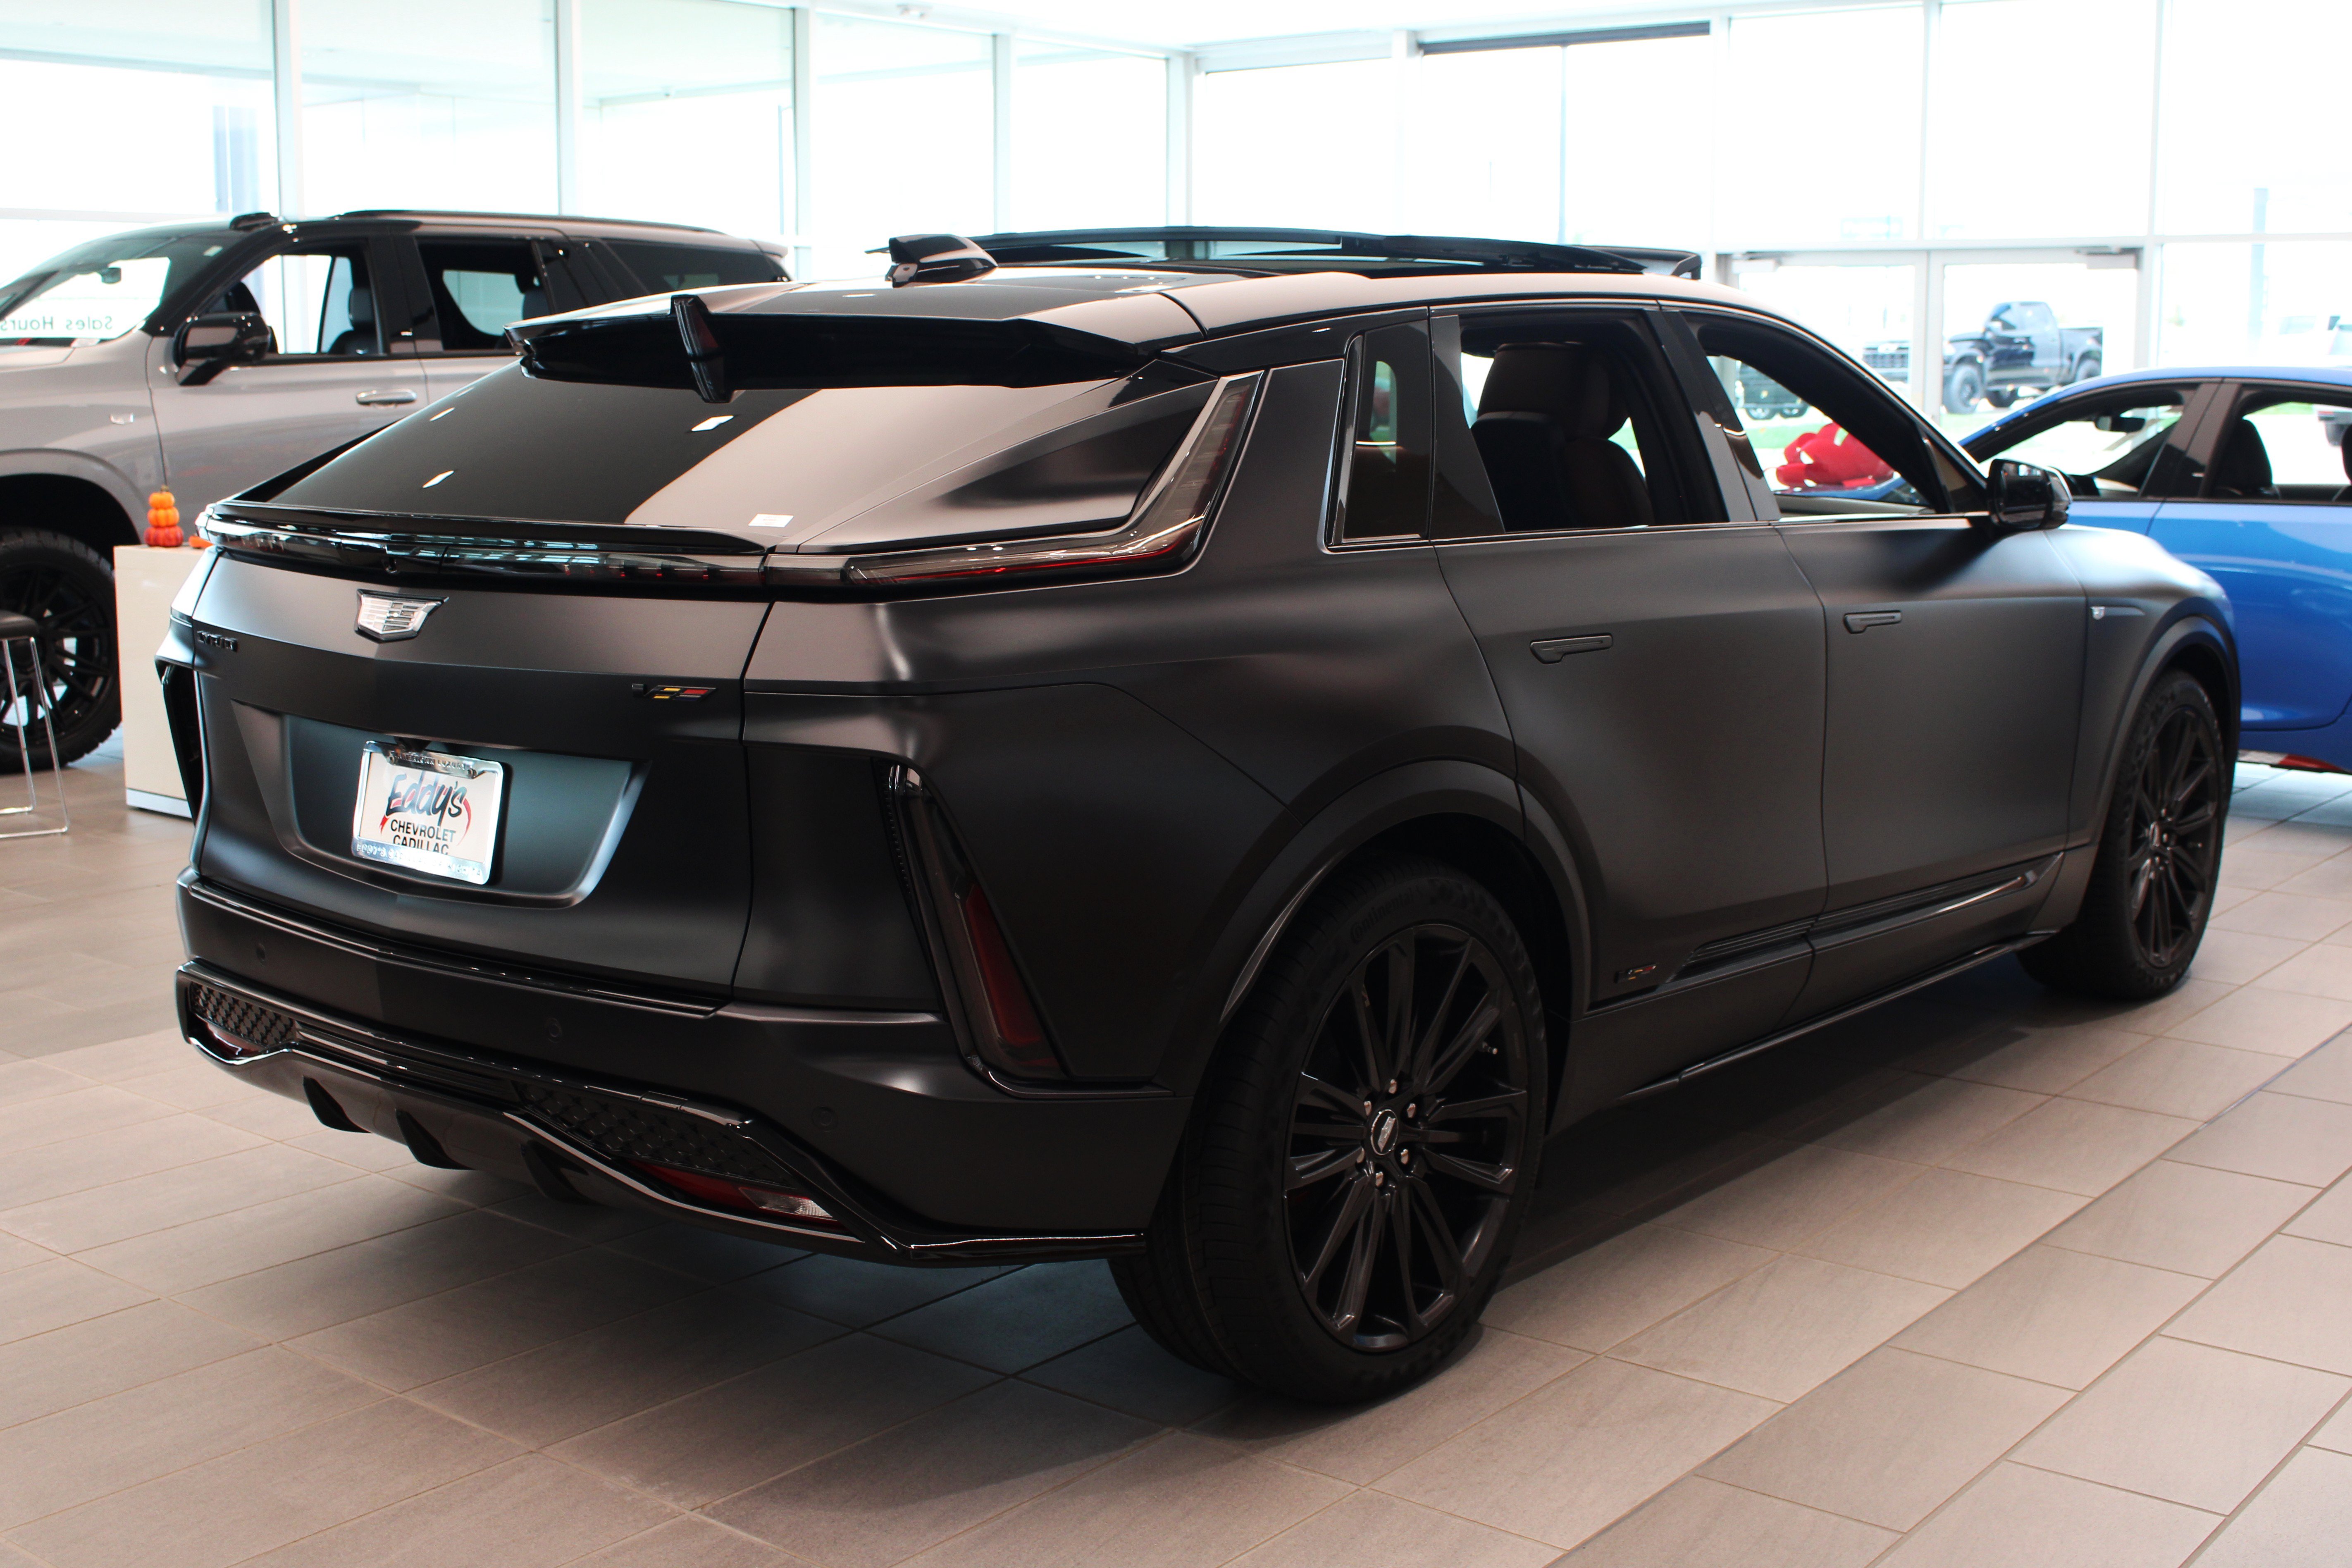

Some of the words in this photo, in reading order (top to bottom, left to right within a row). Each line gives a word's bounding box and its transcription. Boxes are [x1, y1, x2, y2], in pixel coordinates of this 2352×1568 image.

[437, 759, 466, 770] LUXURY
[385, 771, 468, 825] Eddy's
[391, 819, 456, 842] CHEVROLET
